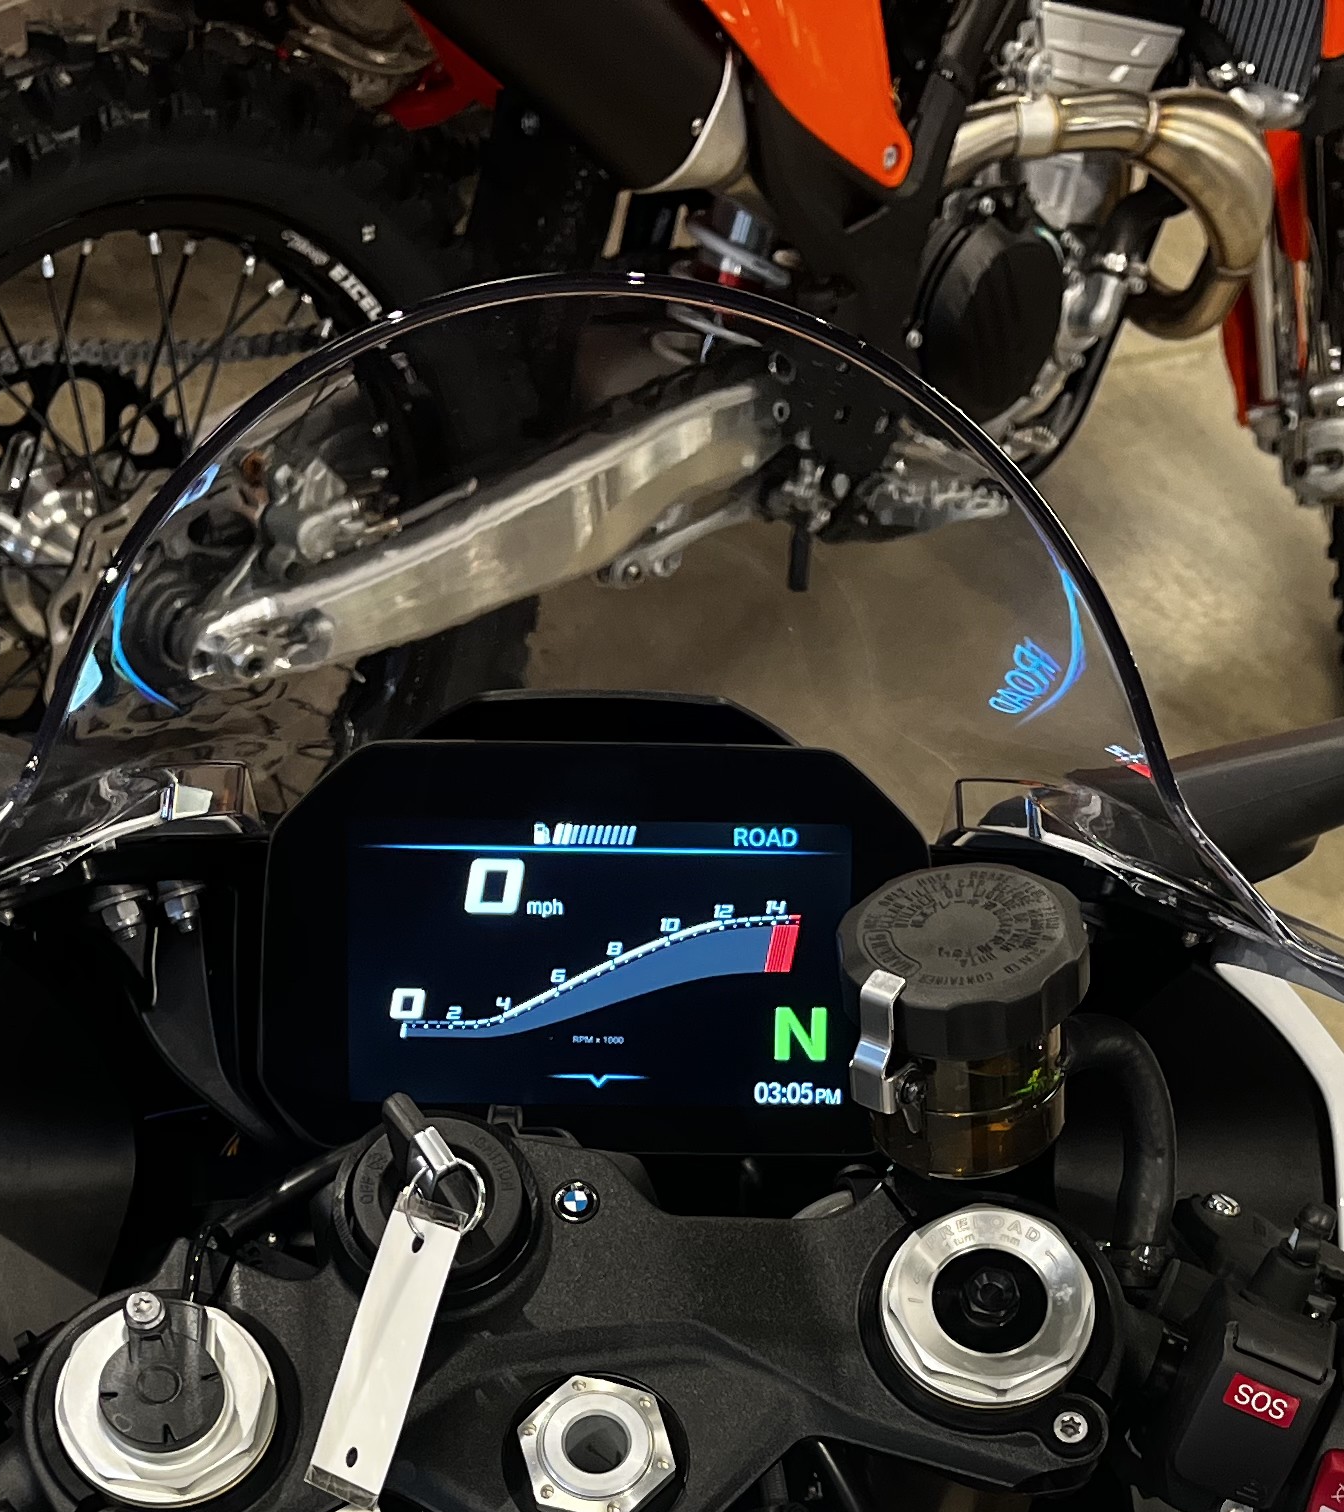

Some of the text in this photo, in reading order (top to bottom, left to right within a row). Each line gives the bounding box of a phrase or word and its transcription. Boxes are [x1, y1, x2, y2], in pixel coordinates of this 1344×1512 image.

[328, 261, 383, 322] EXCEL
[733, 827, 798, 847] ROAD
[463, 858, 564, 918] 0 mph
[714, 904, 735, 919] 12
[766, 900, 787, 914] 14
[660, 917, 681, 932] 10
[606, 941, 623, 956] 8
[550, 968, 567, 983] 6
[389, 987, 426, 1019] 0
[495, 996, 512, 1010] 4
[446, 1005, 462, 1020] 2
[572, 1035, 594, 1045] RPM
[603, 1035, 625, 1045] 1000
[774, 1006, 827, 1061] N
[925, 1214, 1041, 1250] PRELOAD
[1234, 1383, 1288, 1420] SOS
